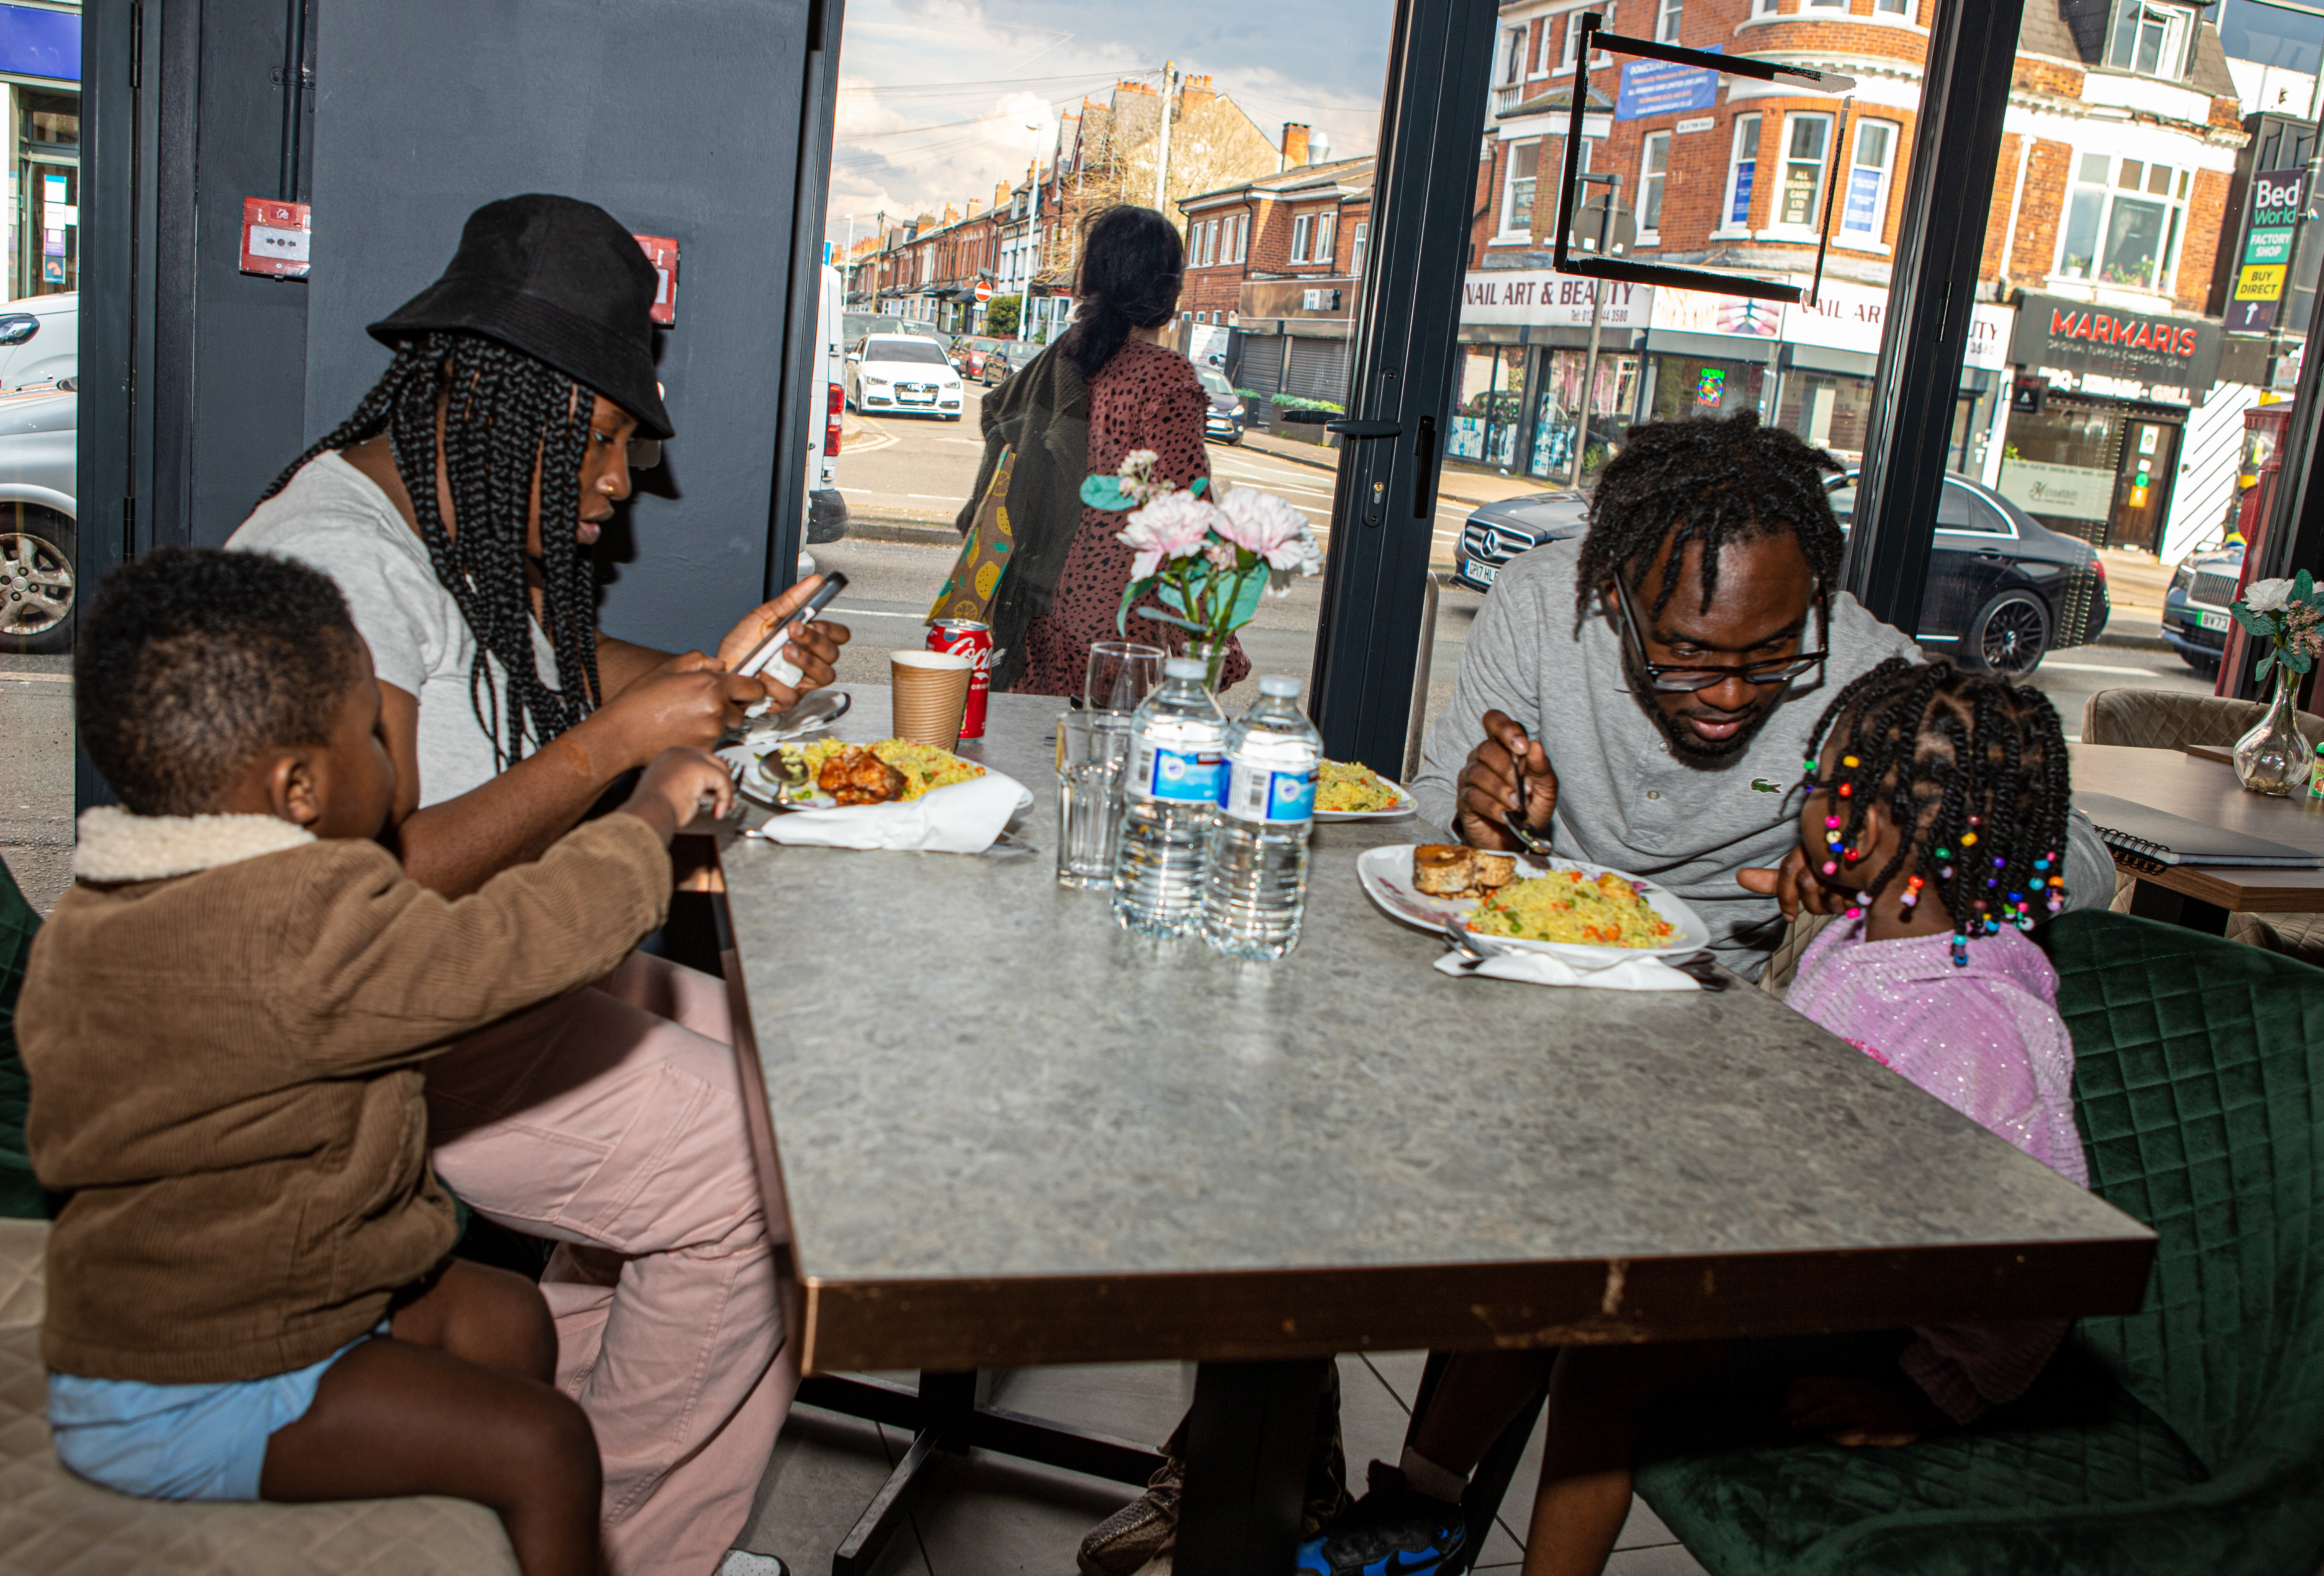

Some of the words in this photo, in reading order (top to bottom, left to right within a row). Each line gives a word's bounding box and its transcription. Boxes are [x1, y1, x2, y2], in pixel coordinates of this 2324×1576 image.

[1794, 171, 1809, 180] ALL
[1789, 189, 1810, 200] CARE
[2255, 178, 2301, 208] Bed
[1791, 200, 1805, 209] LTD
[2254, 207, 2297, 225] World
[2250, 232, 2291, 245] FACTORY
[2255, 245, 2282, 258] SHOP
[2252, 271, 2273, 282] BUY
[1463, 282, 1497, 305] NAIL
[1502, 281, 1536, 305] ART
[1540, 281, 1554, 305] &
[2240, 283, 2277, 295] DIRECT
[1611, 309, 1628, 322] 3580
[1852, 304, 1886, 324] AR
[2049, 308, 2197, 357] MARMARIS
[1701, 368, 1725, 380] OPEN
[2149, 383, 2191, 406] GRILL
[1470, 562, 1483, 578] GP17
[2203, 614, 2228, 629] BV73
